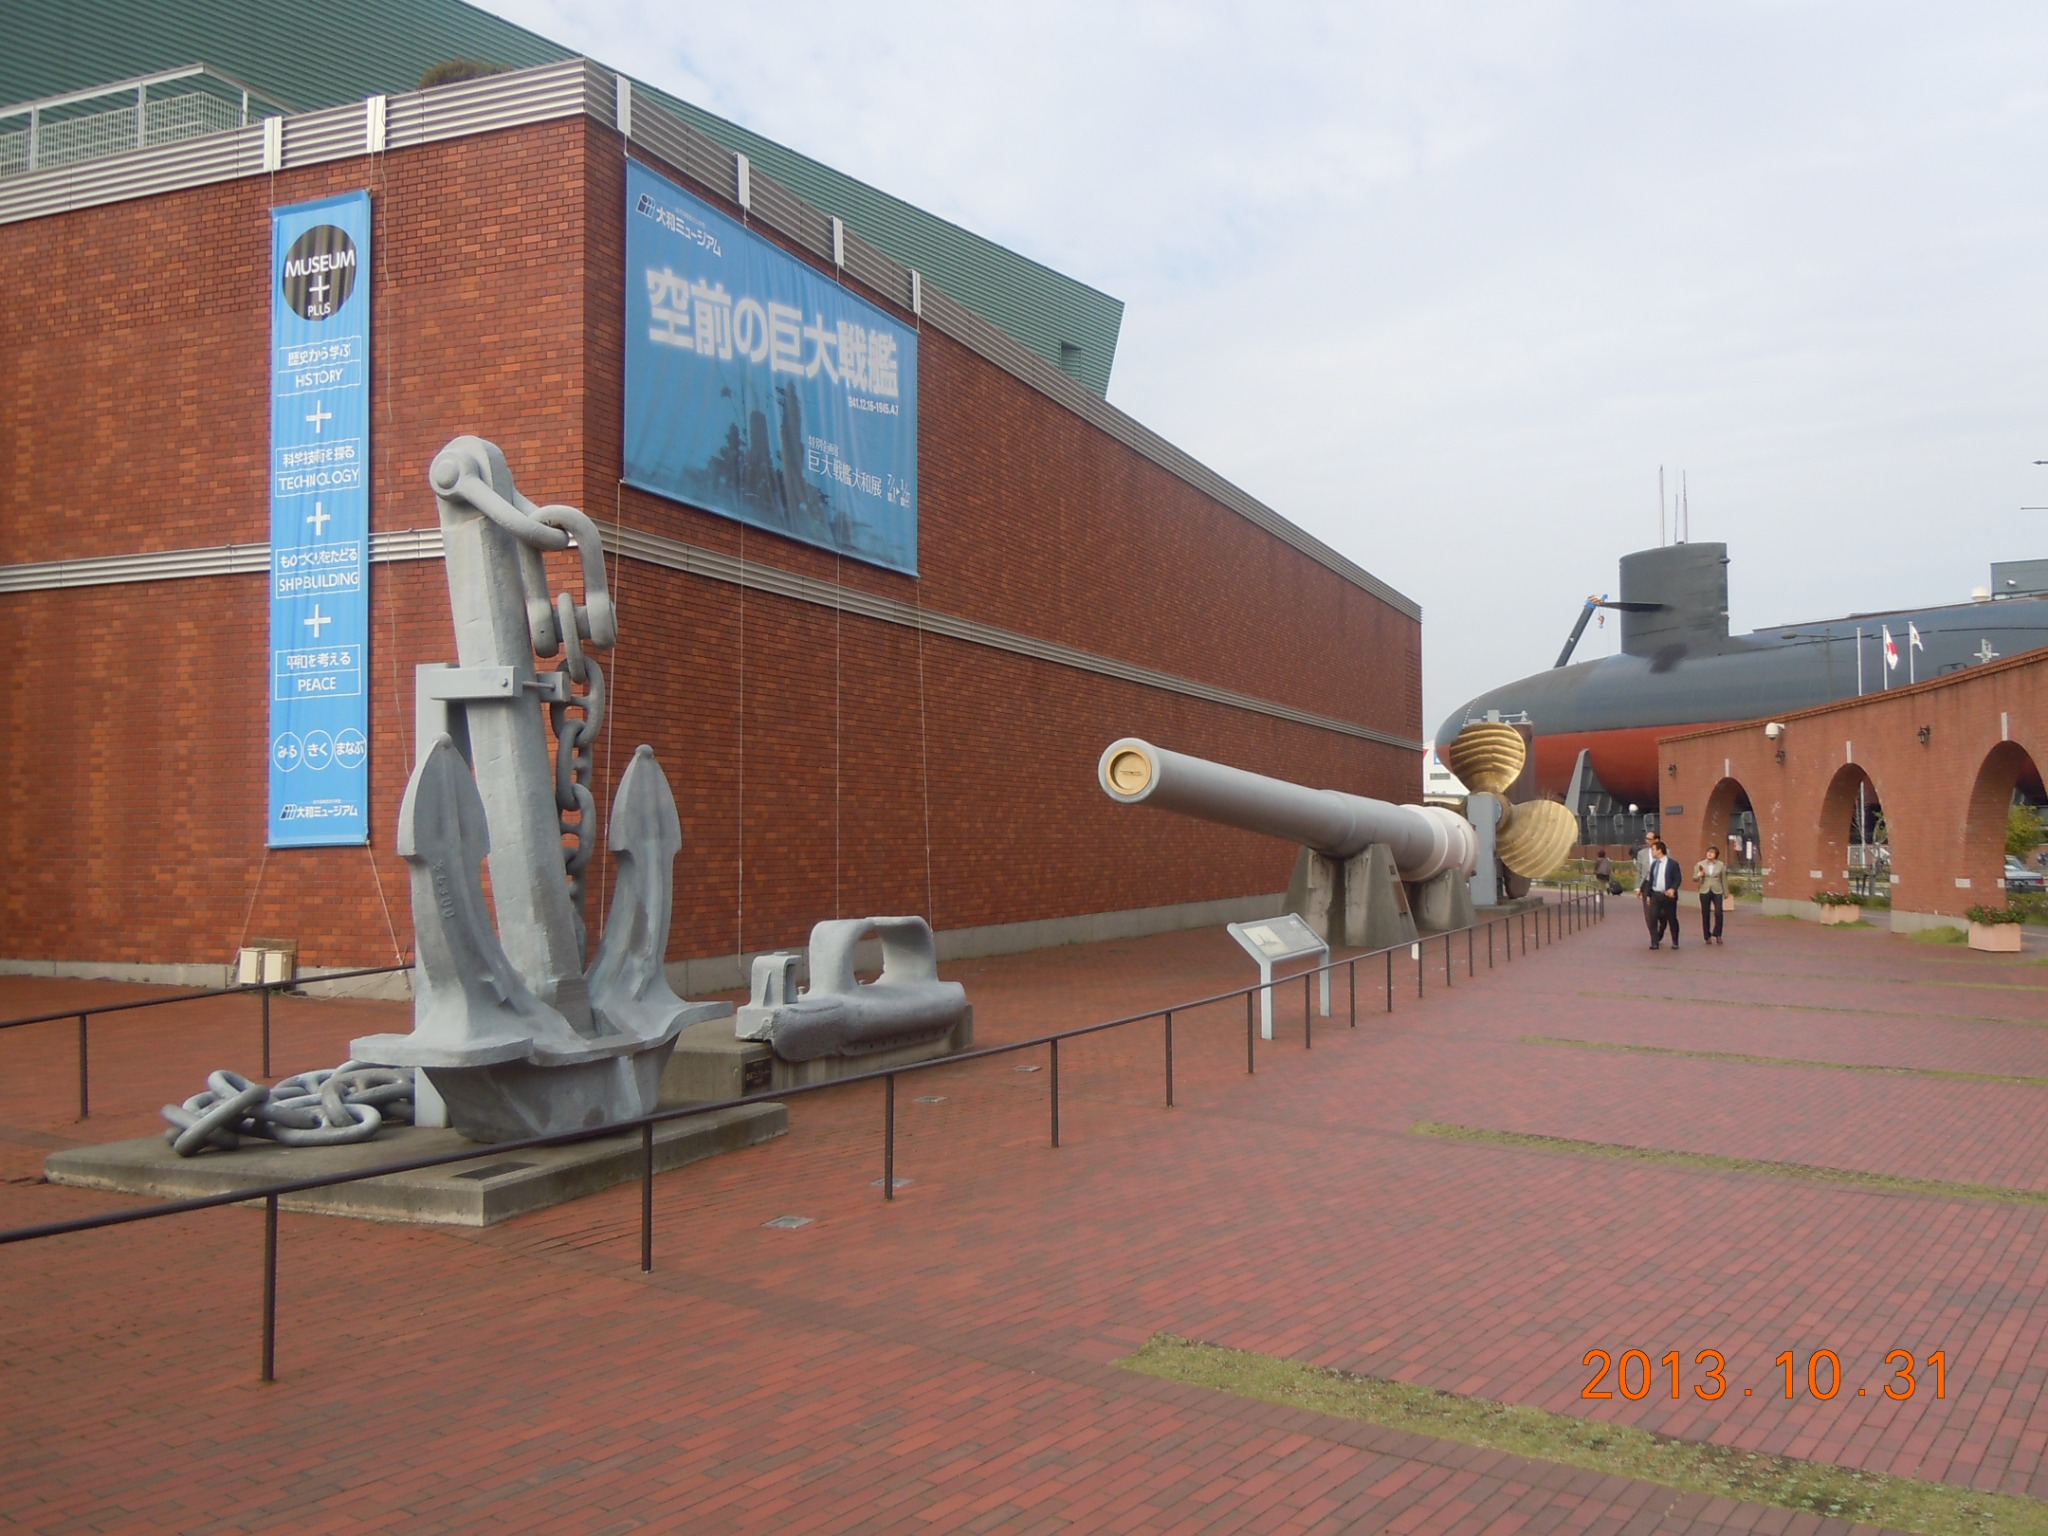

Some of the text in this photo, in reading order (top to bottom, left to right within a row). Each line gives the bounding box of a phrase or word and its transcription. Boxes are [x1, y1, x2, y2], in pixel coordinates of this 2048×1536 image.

[656, 207, 722, 258] 大和ミュージアム
[285, 249, 356, 278] MUSEUM
[307, 302, 331, 317] PLUS
[646, 267, 900, 398] 空前の巨大戦艦
[288, 343, 351, 367] 歴史から学ぶ
[283, 445, 355, 468] 科学技術を探る
[278, 468, 360, 491] TECHNOLOGY
[808, 449, 882, 498] 巨大戦艦大和展
[280, 547, 357, 568] ものづくりをたどる
[279, 571, 359, 592] SHPBUILDING
[286, 651, 351, 670] 平和を考える
[297, 676, 336, 692] PEACE
[336, 741, 365, 756] まなぶ
[296, 804, 358, 818] 大和ミュージアム
